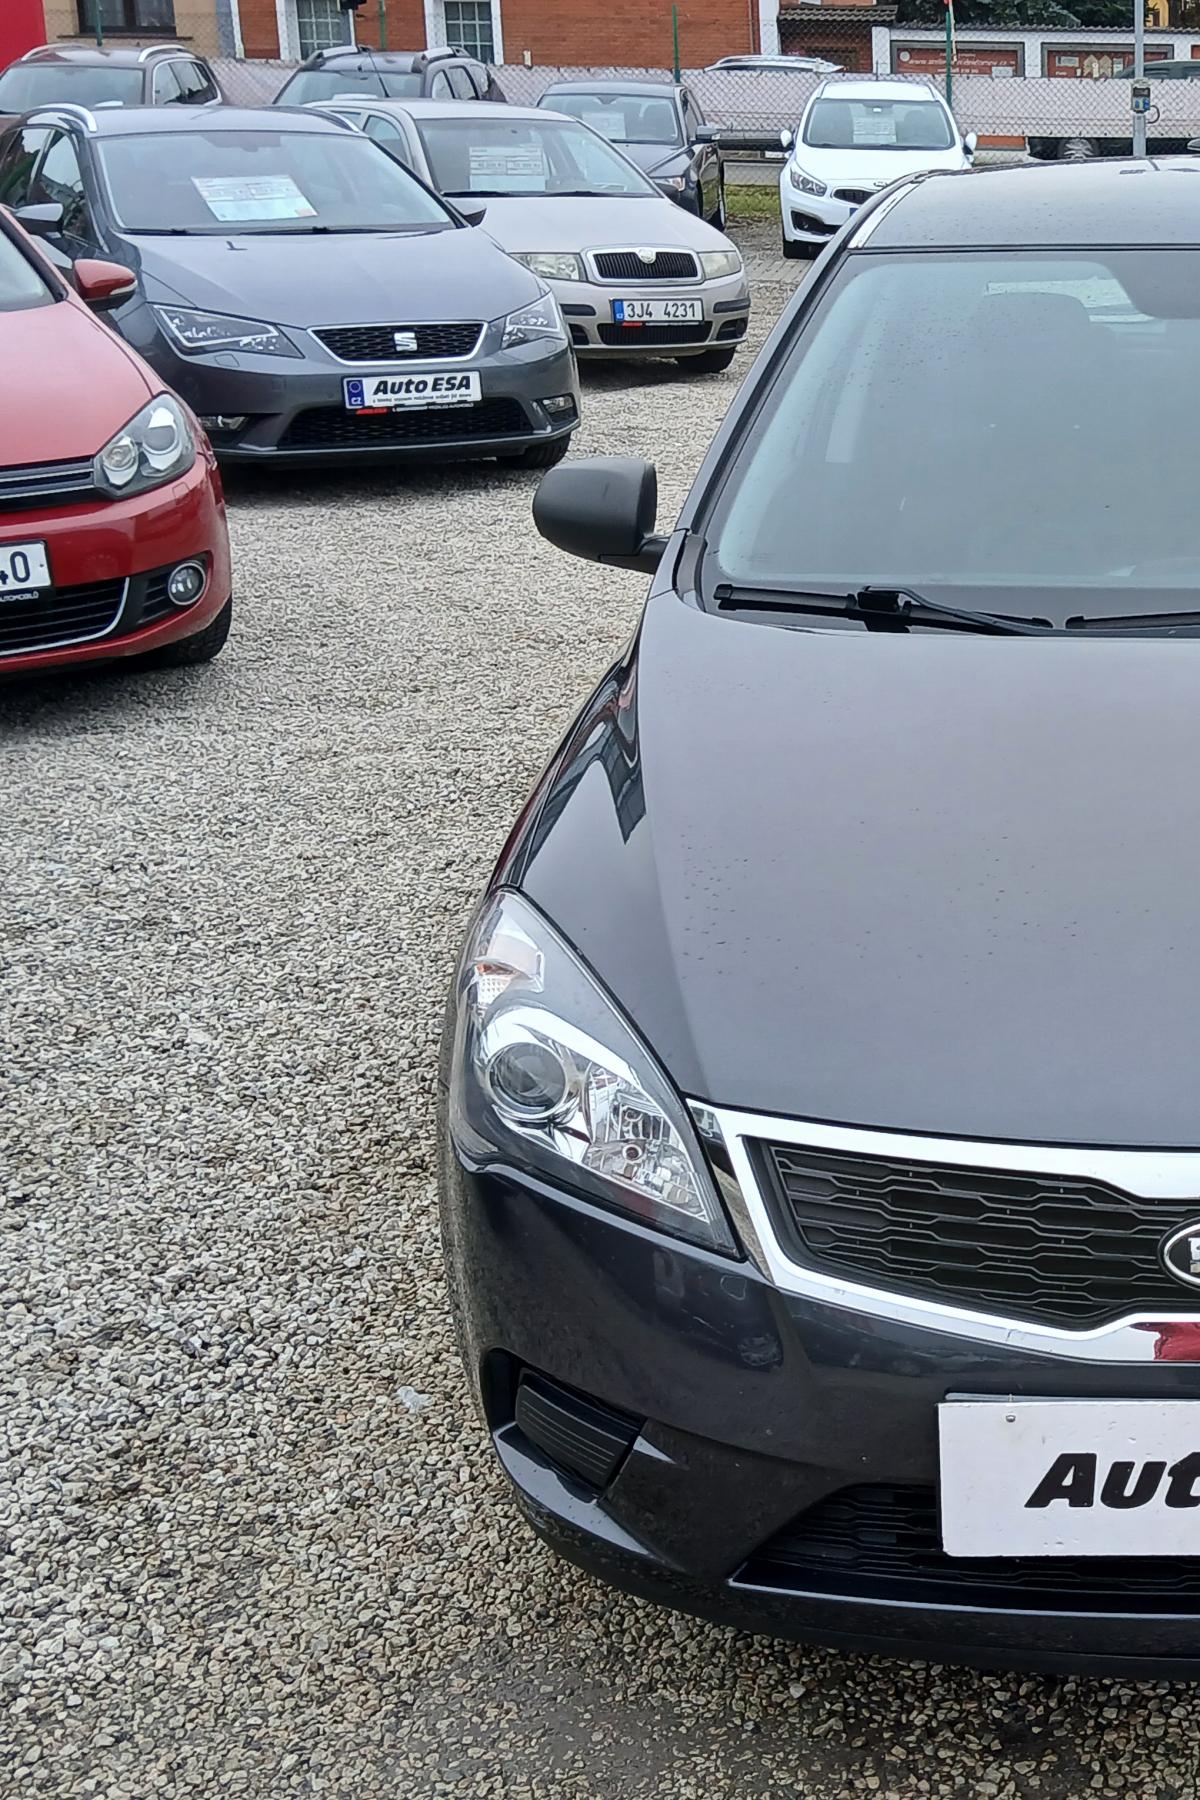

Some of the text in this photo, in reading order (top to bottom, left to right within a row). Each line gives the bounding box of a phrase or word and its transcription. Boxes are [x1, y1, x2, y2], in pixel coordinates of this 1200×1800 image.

[627, 302, 695, 318] 3J4 4231
[373, 376, 471, 395] Auto ESA
